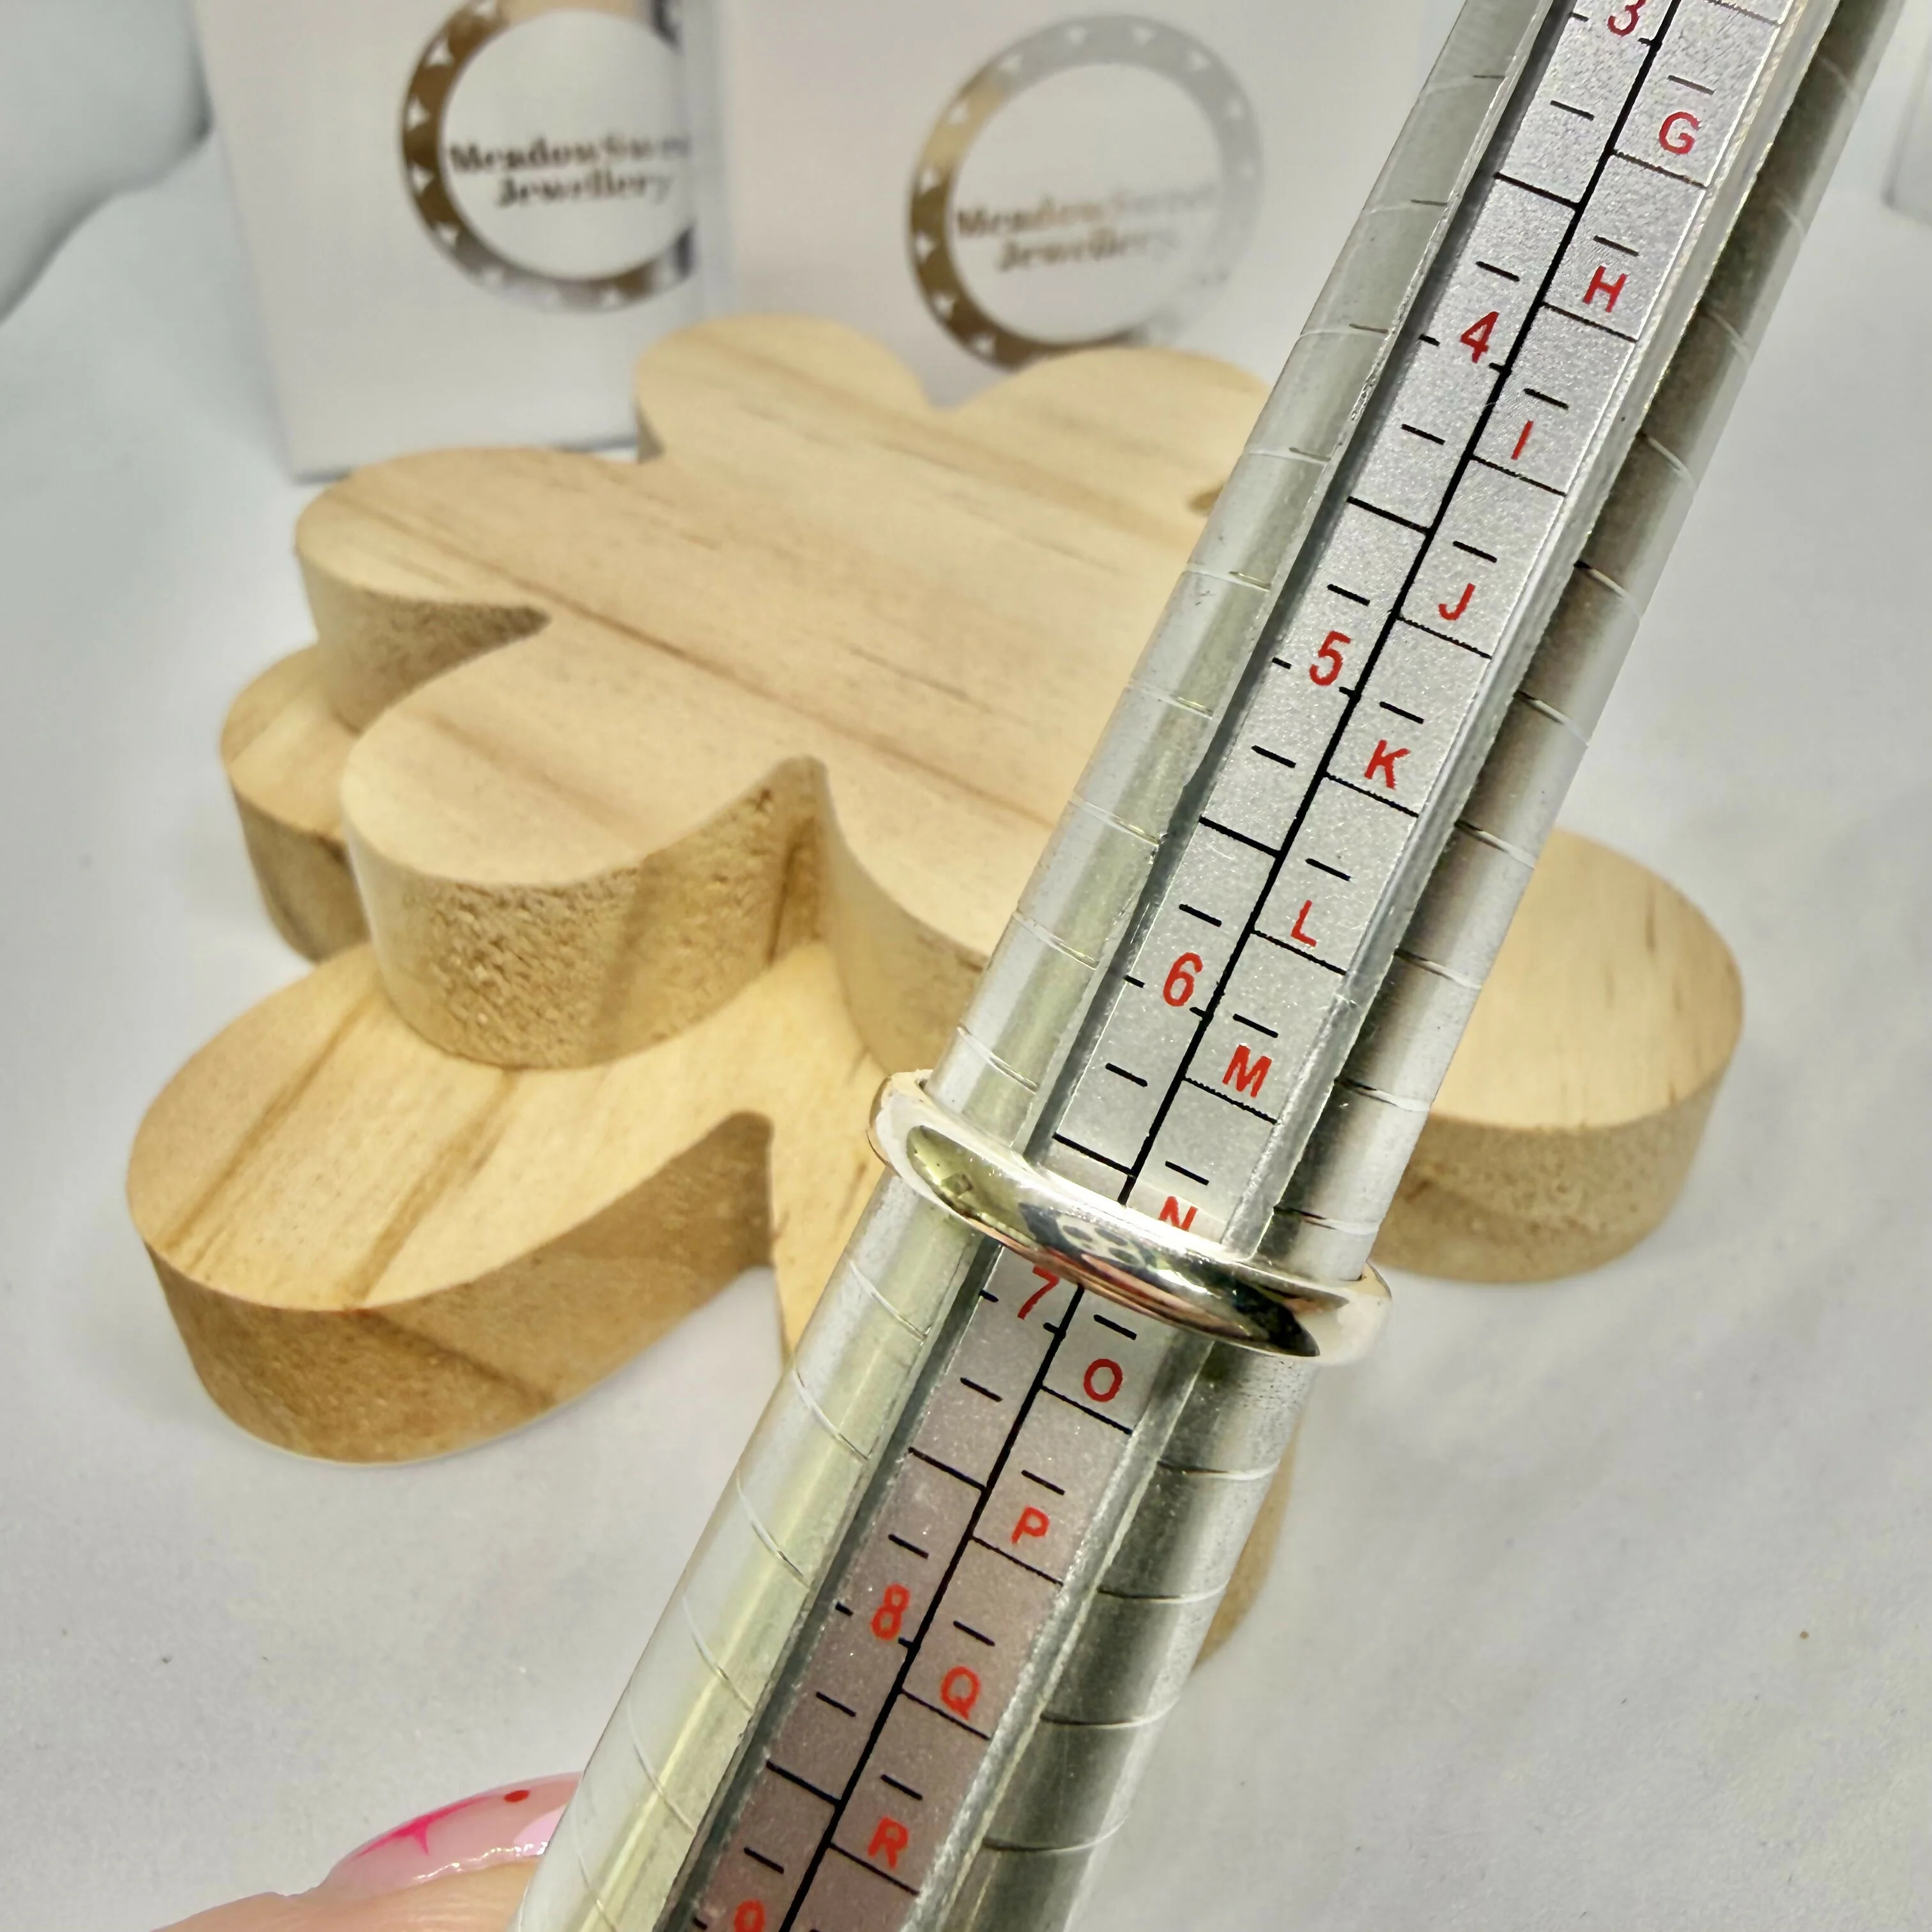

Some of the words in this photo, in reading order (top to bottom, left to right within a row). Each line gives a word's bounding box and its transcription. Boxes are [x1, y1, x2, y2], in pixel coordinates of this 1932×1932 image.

[1607, 0, 1646, 36] 3
[1659, 111, 1700, 155] G
[1583, 265, 1627, 313] H
[1460, 311, 1499, 363] 4
[1438, 583, 1476, 622] J
[1309, 631, 1351, 686] 5
[1364, 740, 1410, 790] K
[1290, 900, 1317, 947] L
[1163, 952, 1203, 1007] 6
[1222, 1044, 1271, 1098] M
[1158, 1195, 1199, 1231] N
[1017, 1267, 1060, 1320] 7
[1084, 1358, 1124, 1402] O
[1010, 1505, 1050, 1544] P
[870, 1583, 911, 1640] 8
[939, 1666, 982, 1720] Q
[866, 1814, 910, 1870] R
